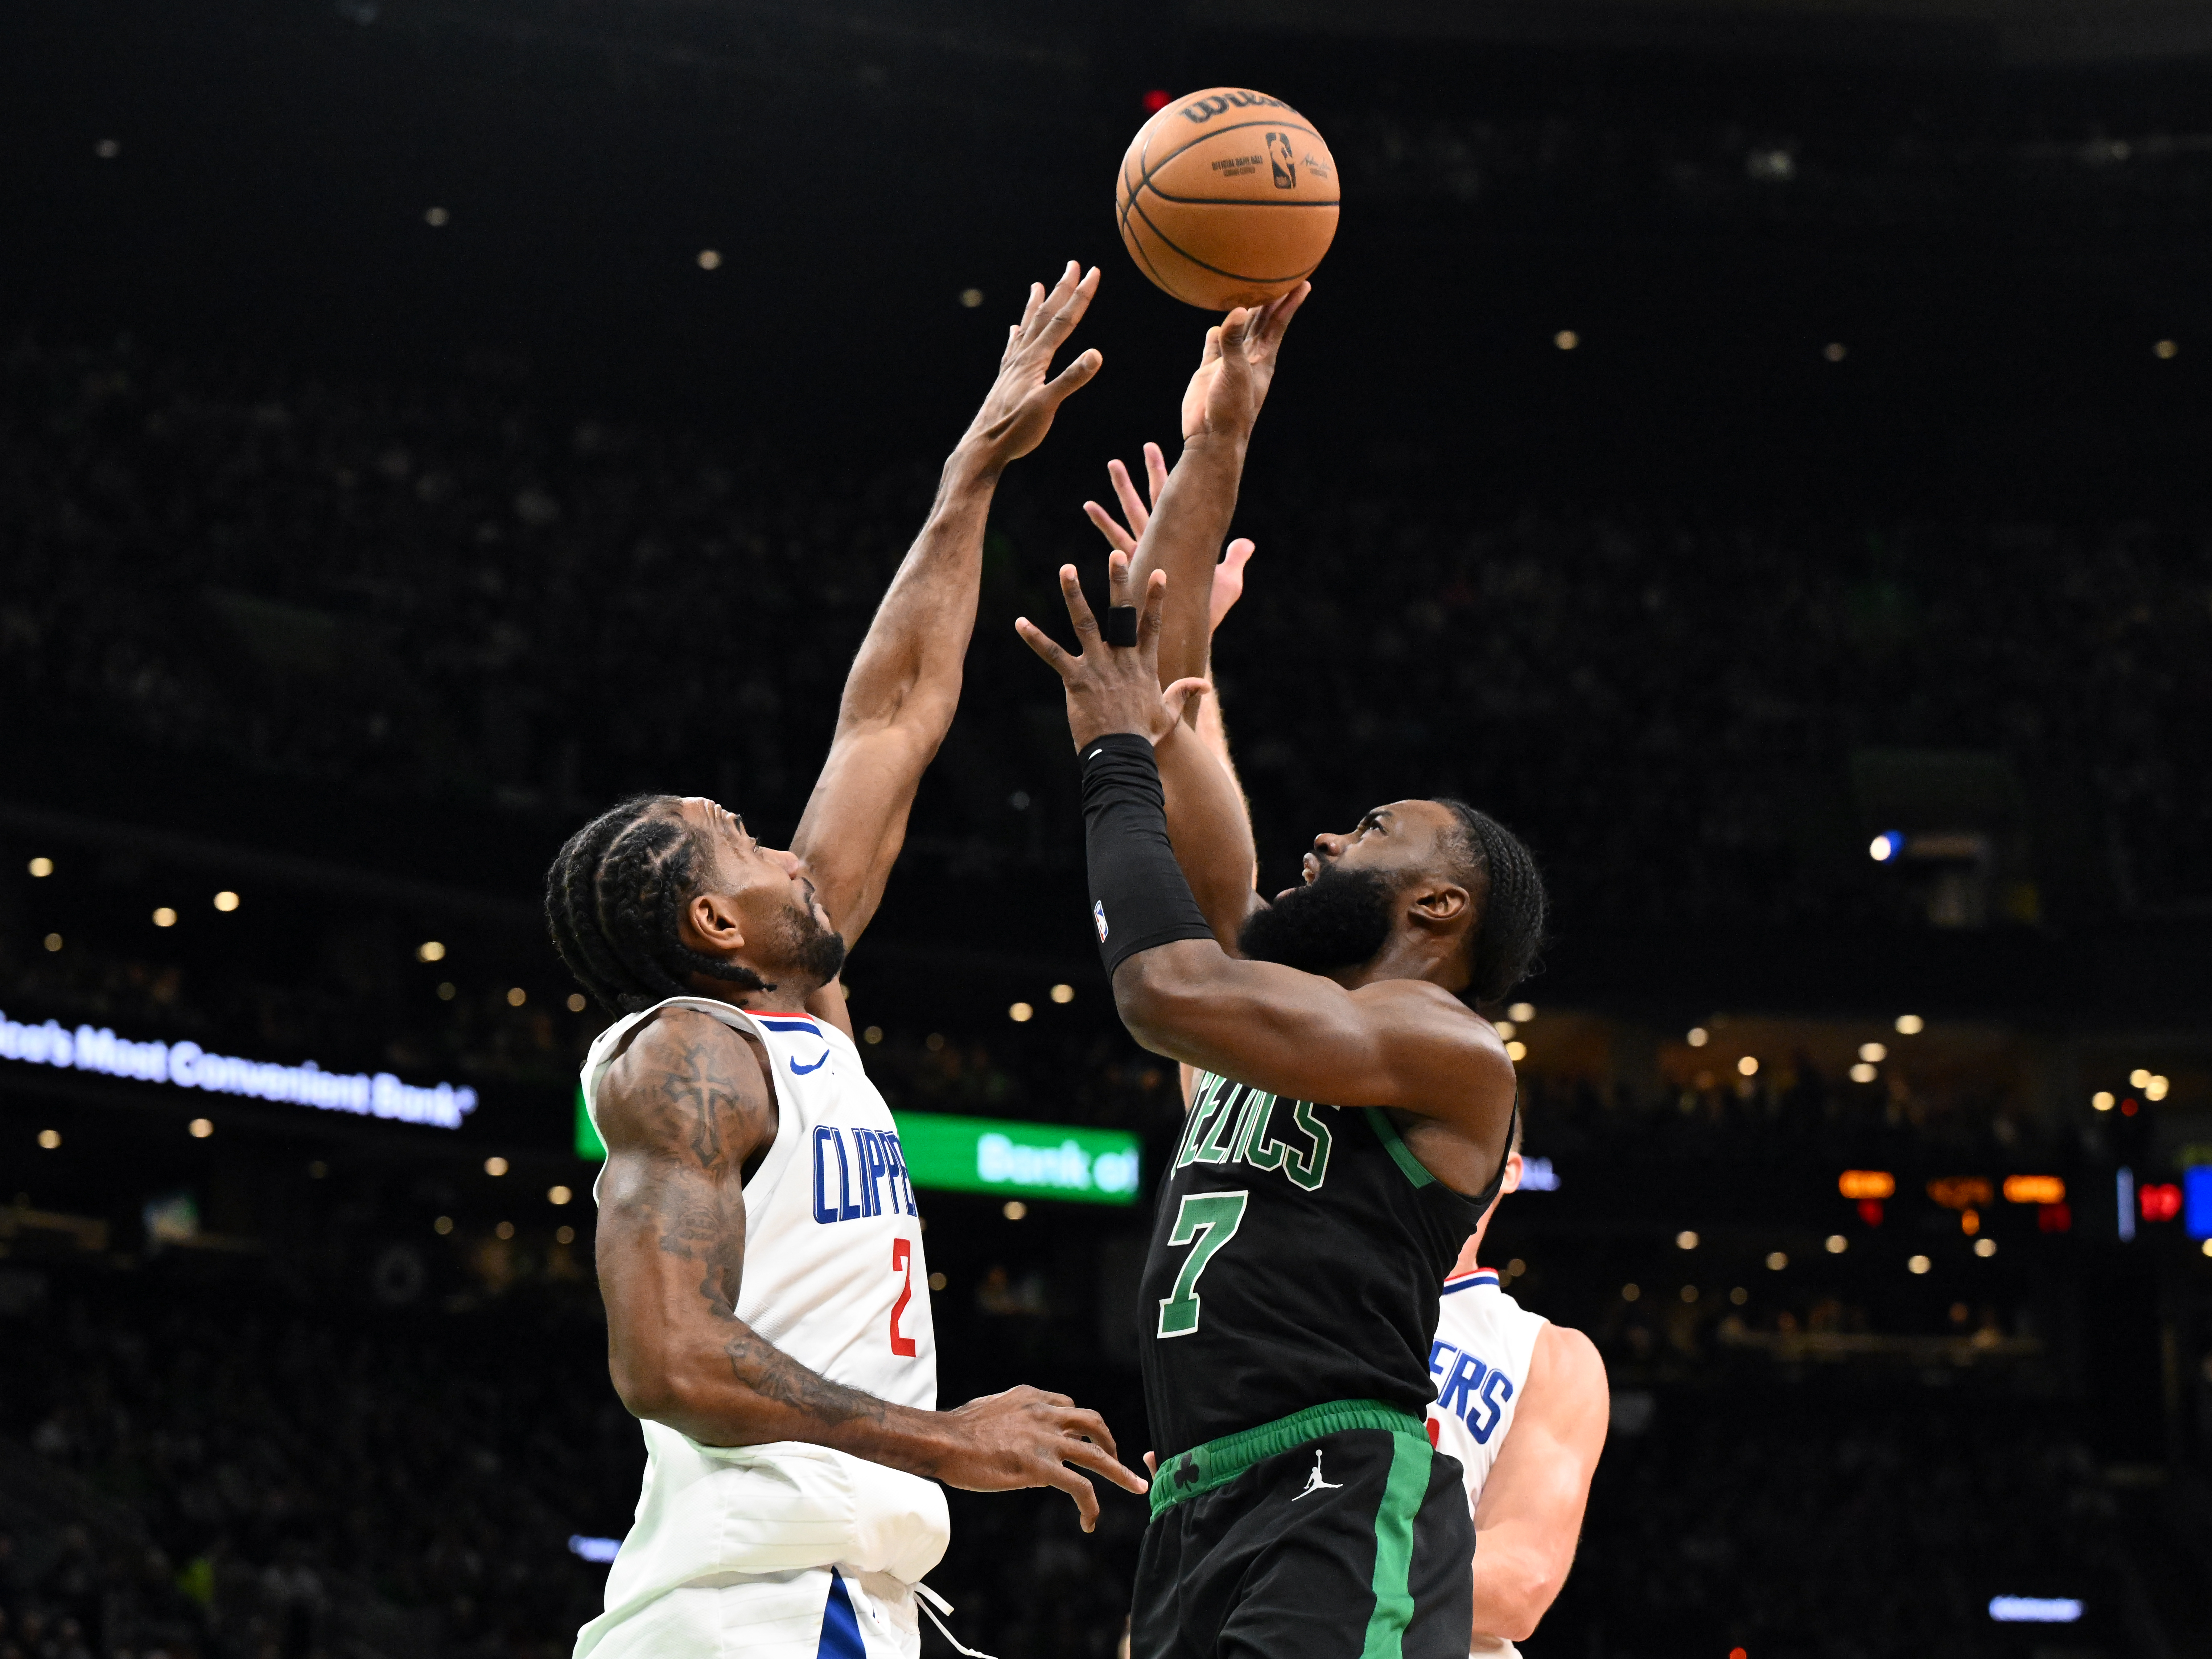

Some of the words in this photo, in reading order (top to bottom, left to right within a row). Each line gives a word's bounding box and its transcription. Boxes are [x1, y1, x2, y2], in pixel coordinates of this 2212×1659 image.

[813, 1125, 917, 1224] CLIPPE
[978, 1132, 1090, 1191] Bank
[1171, 1071, 1340, 1191] ELTICS
[890, 1238, 916, 1357] 2
[1157, 1190, 1248, 1339] 7
[1428, 1338, 1513, 1445] ERS
